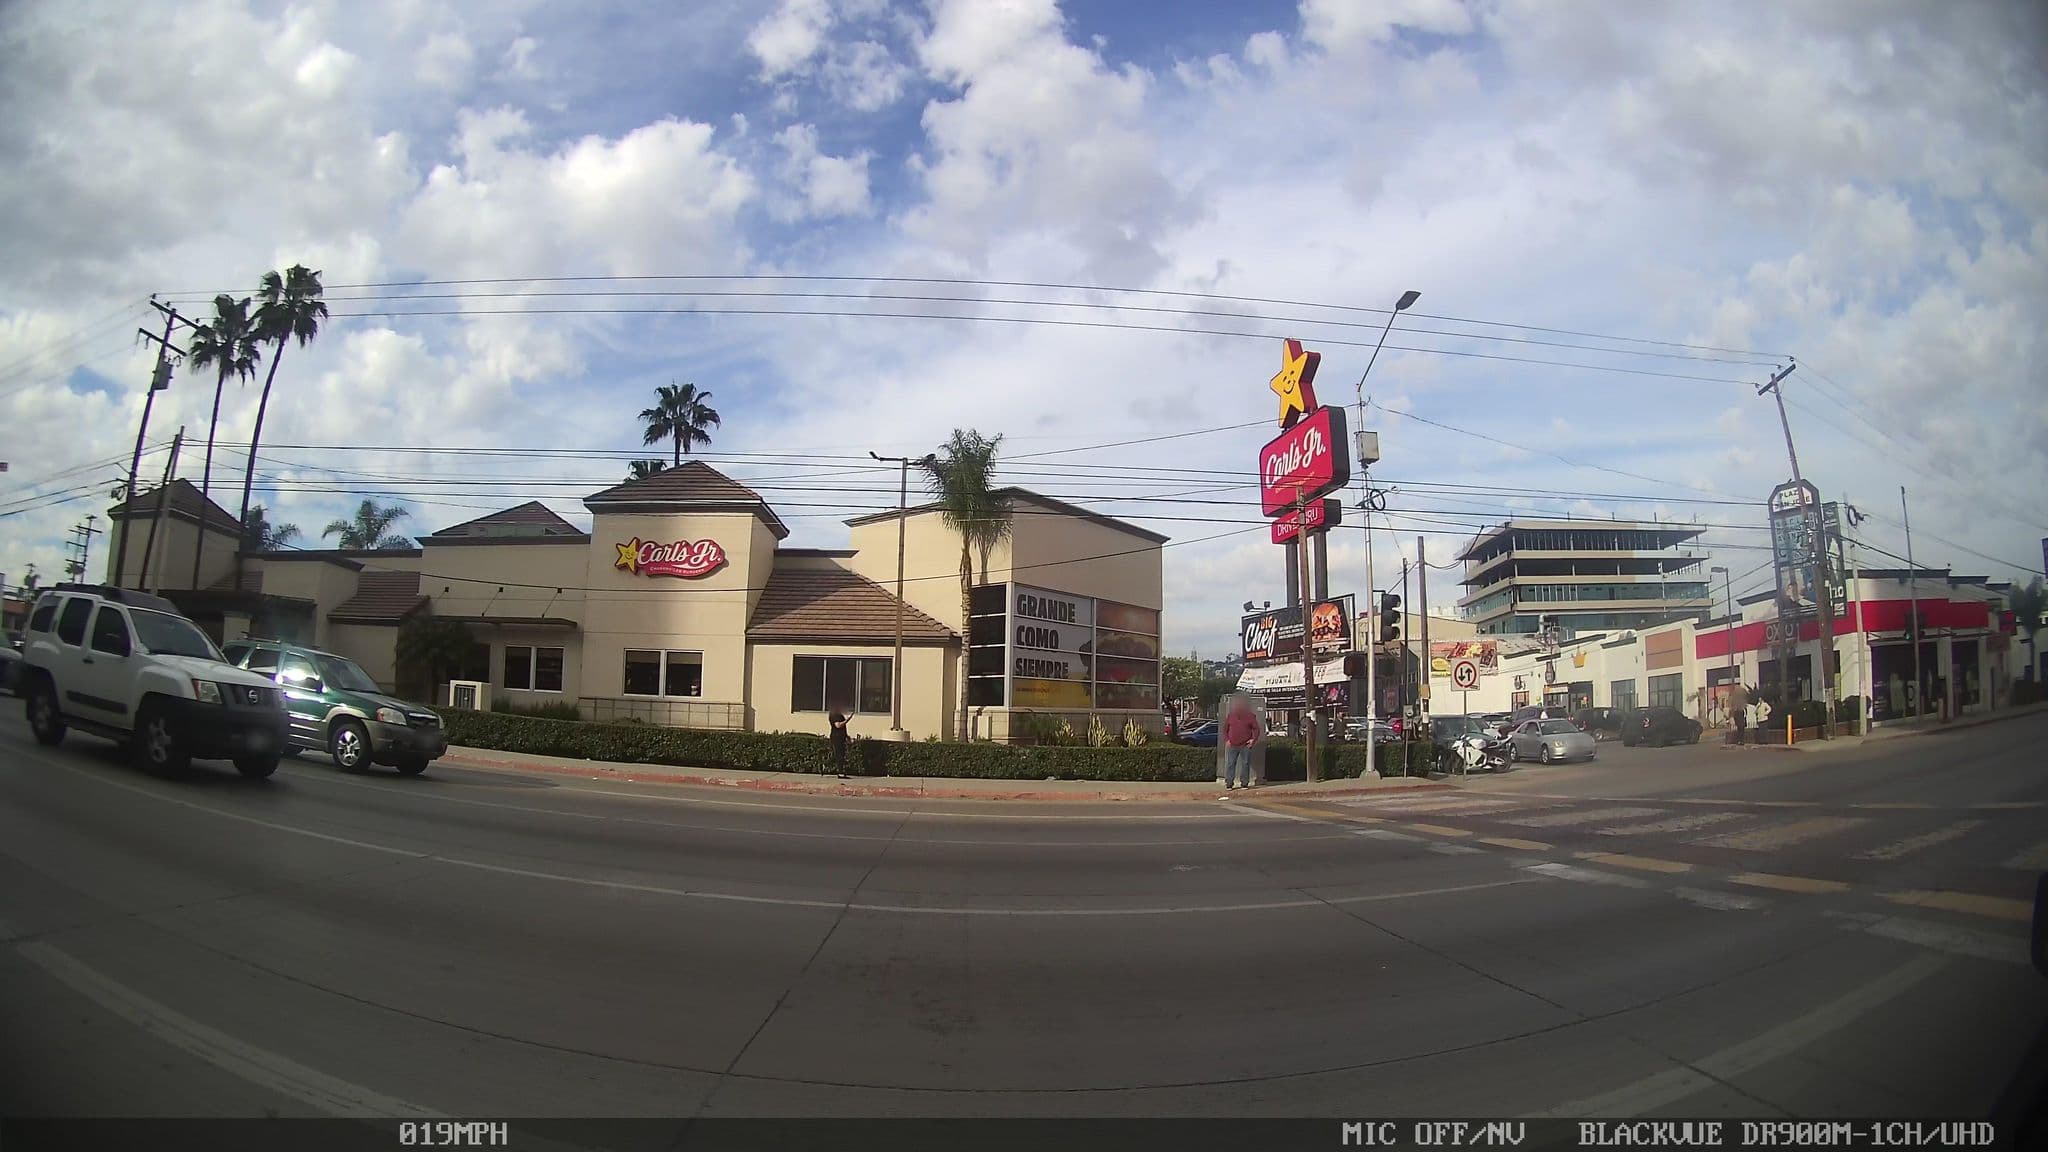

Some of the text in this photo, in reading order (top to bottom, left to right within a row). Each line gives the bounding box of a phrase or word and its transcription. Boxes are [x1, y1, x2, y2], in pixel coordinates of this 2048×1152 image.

[1265, 438, 1302, 489] Carl's
[1302, 426, 1326, 468] Jr.
[1780, 489, 1799, 498] PLAZ
[638, 541, 721, 565] Carl's Jr.
[1016, 594, 1076, 623] GRANDE
[1260, 615, 1273, 630] BIG
[1016, 625, 1059, 650] COMO
[1245, 619, 1278, 657] Chef
[1015, 658, 1069, 680] SIEMPRE
